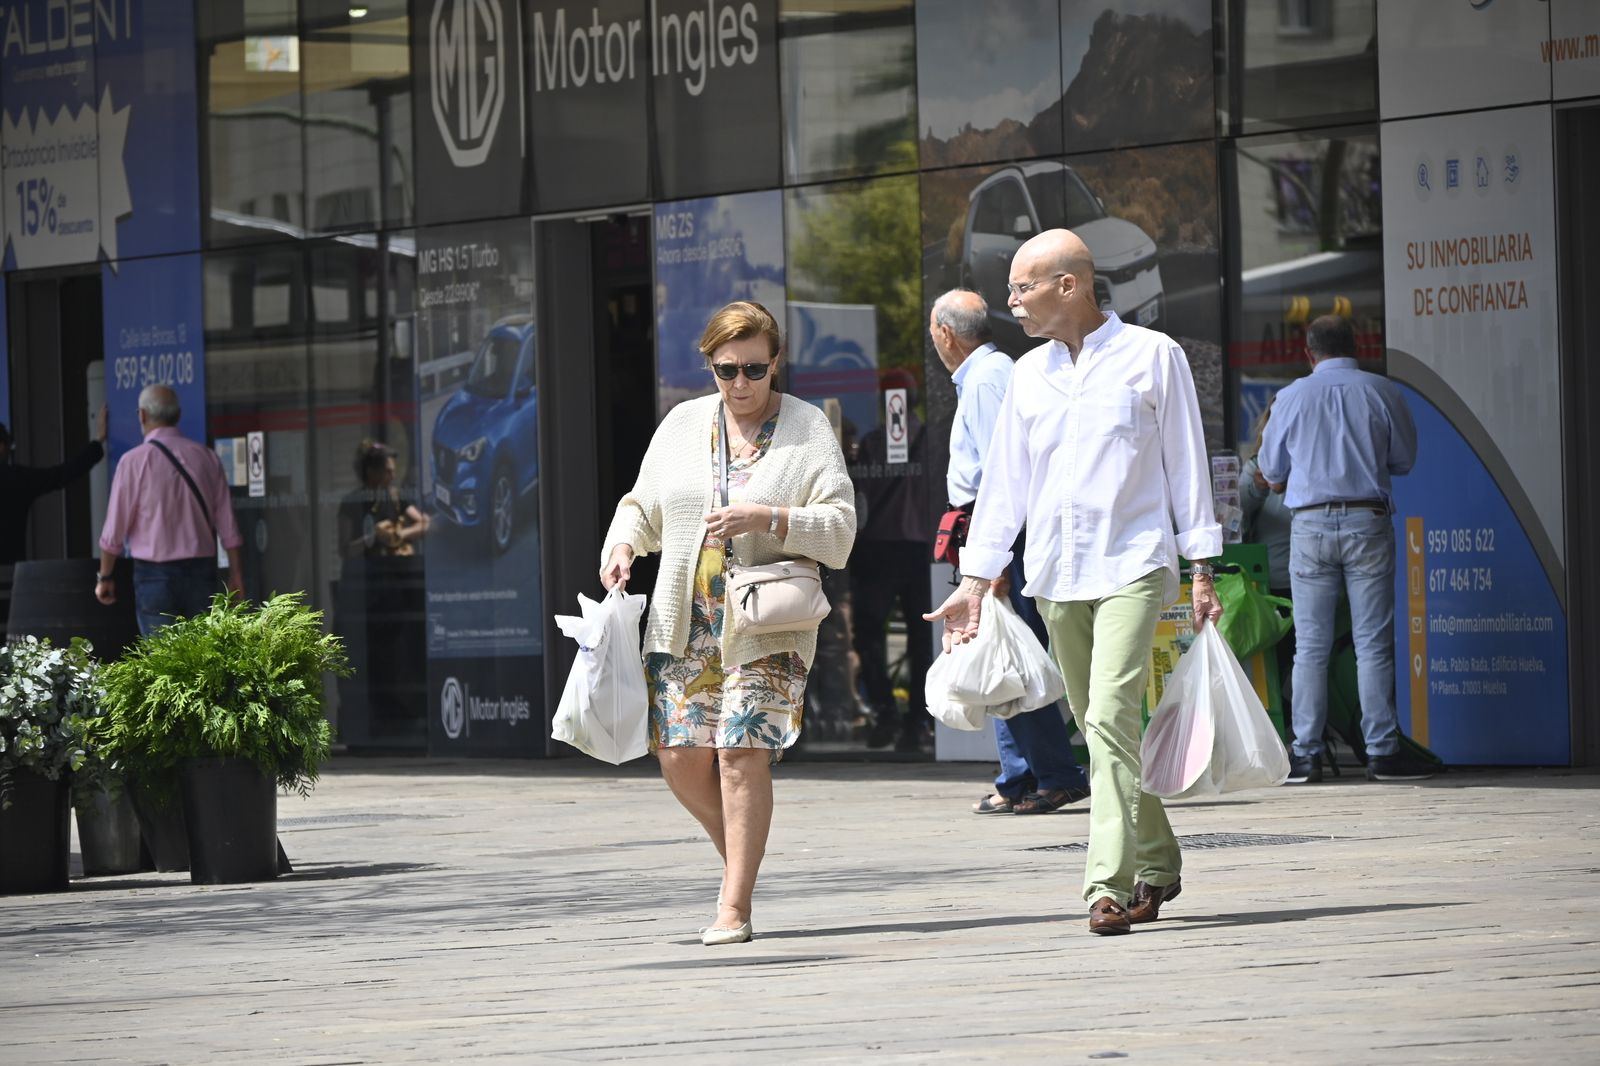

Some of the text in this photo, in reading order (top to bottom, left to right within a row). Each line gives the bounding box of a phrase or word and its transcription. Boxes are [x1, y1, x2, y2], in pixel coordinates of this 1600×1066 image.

[433, 0, 501, 155] MG
[533, 8, 641, 92] Motor
[16, 176, 57, 237] 15%
[656, 212, 694, 240] MG ZS
[418, 248, 437, 274] MG
[438, 246, 455, 273] HS
[469, 242, 499, 269] Turbo
[1407, 232, 1533, 270] SU INMOBILIARIA
[1414, 281, 1528, 316] DE CONFIANZA
[115, 352, 194, 390] 959 54 02 08
[1428, 528, 1495, 553] 959 085 622
[1429, 568, 1492, 592] 617 464 754
[1160, 611, 1187, 620] SIEMPRE
[470, 698, 499, 720] Motor
